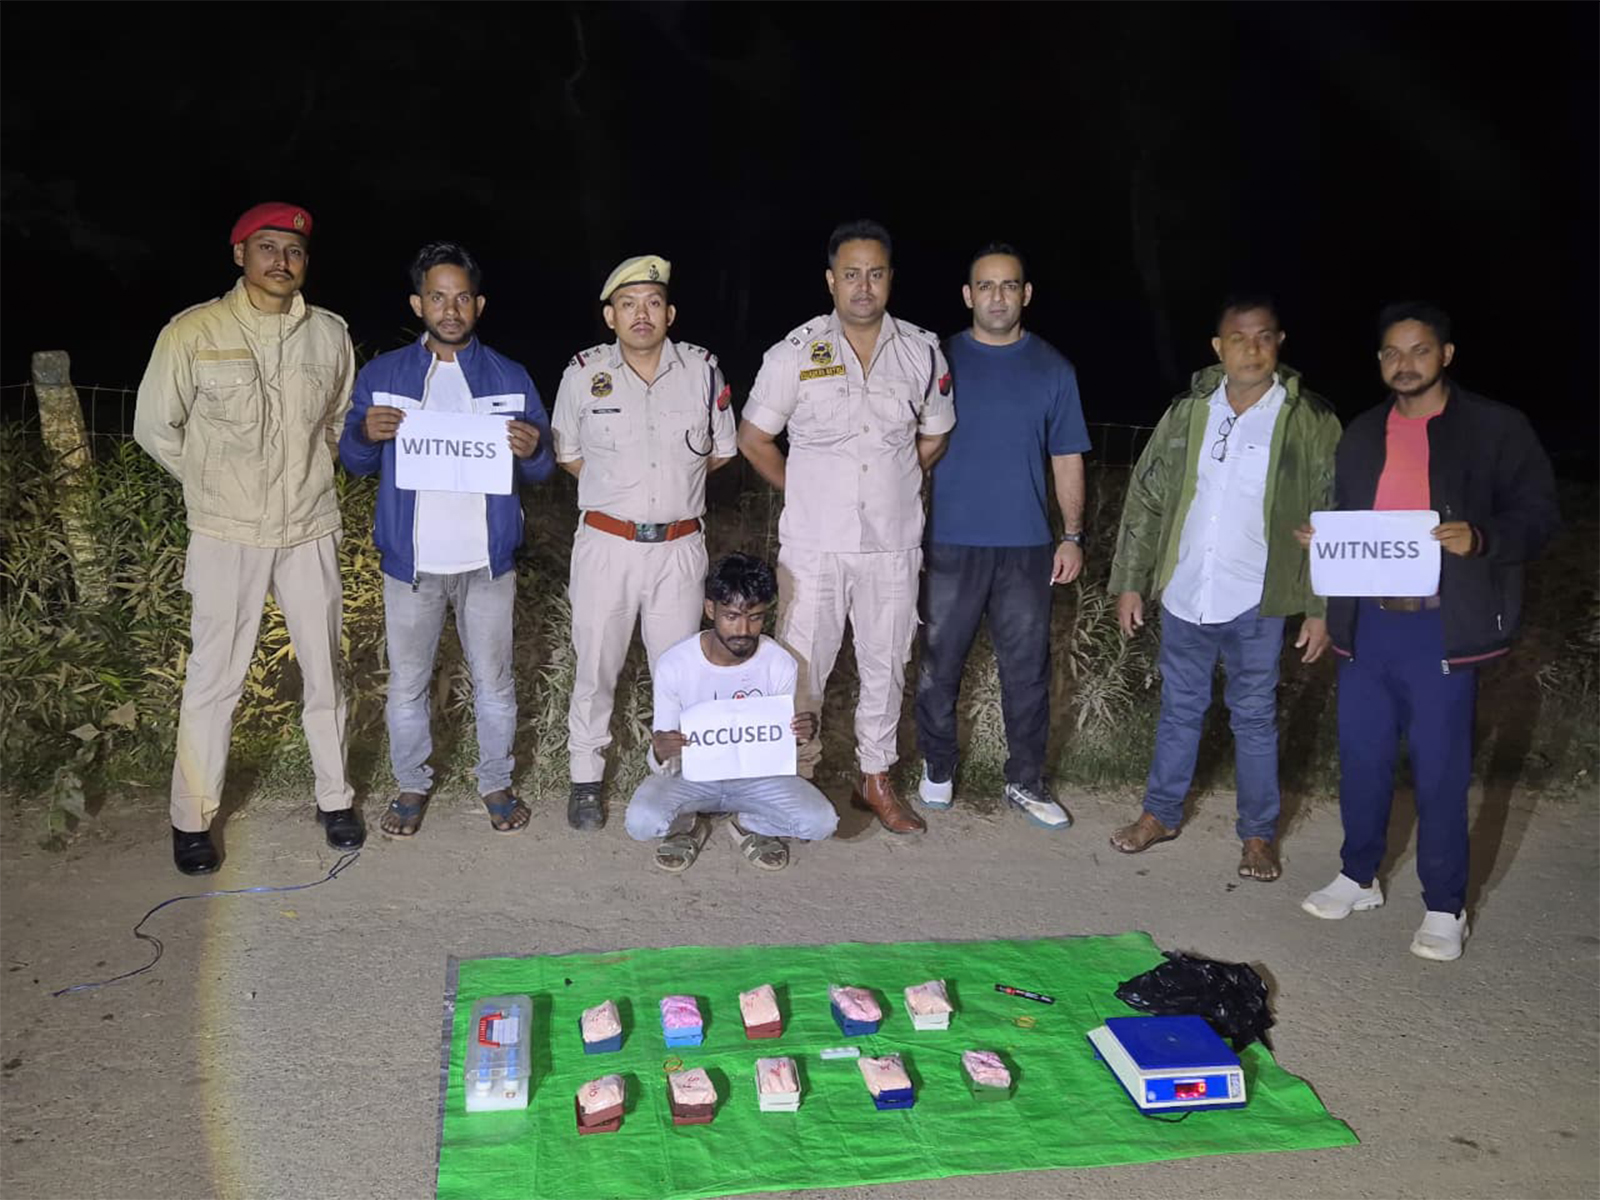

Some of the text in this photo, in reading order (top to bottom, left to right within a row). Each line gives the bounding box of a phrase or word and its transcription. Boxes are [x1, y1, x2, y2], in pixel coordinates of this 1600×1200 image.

[401, 437, 497, 459] WITNESS
[1316, 541, 1420, 559] WITNESS
[688, 725, 783, 746] ACCUSED
